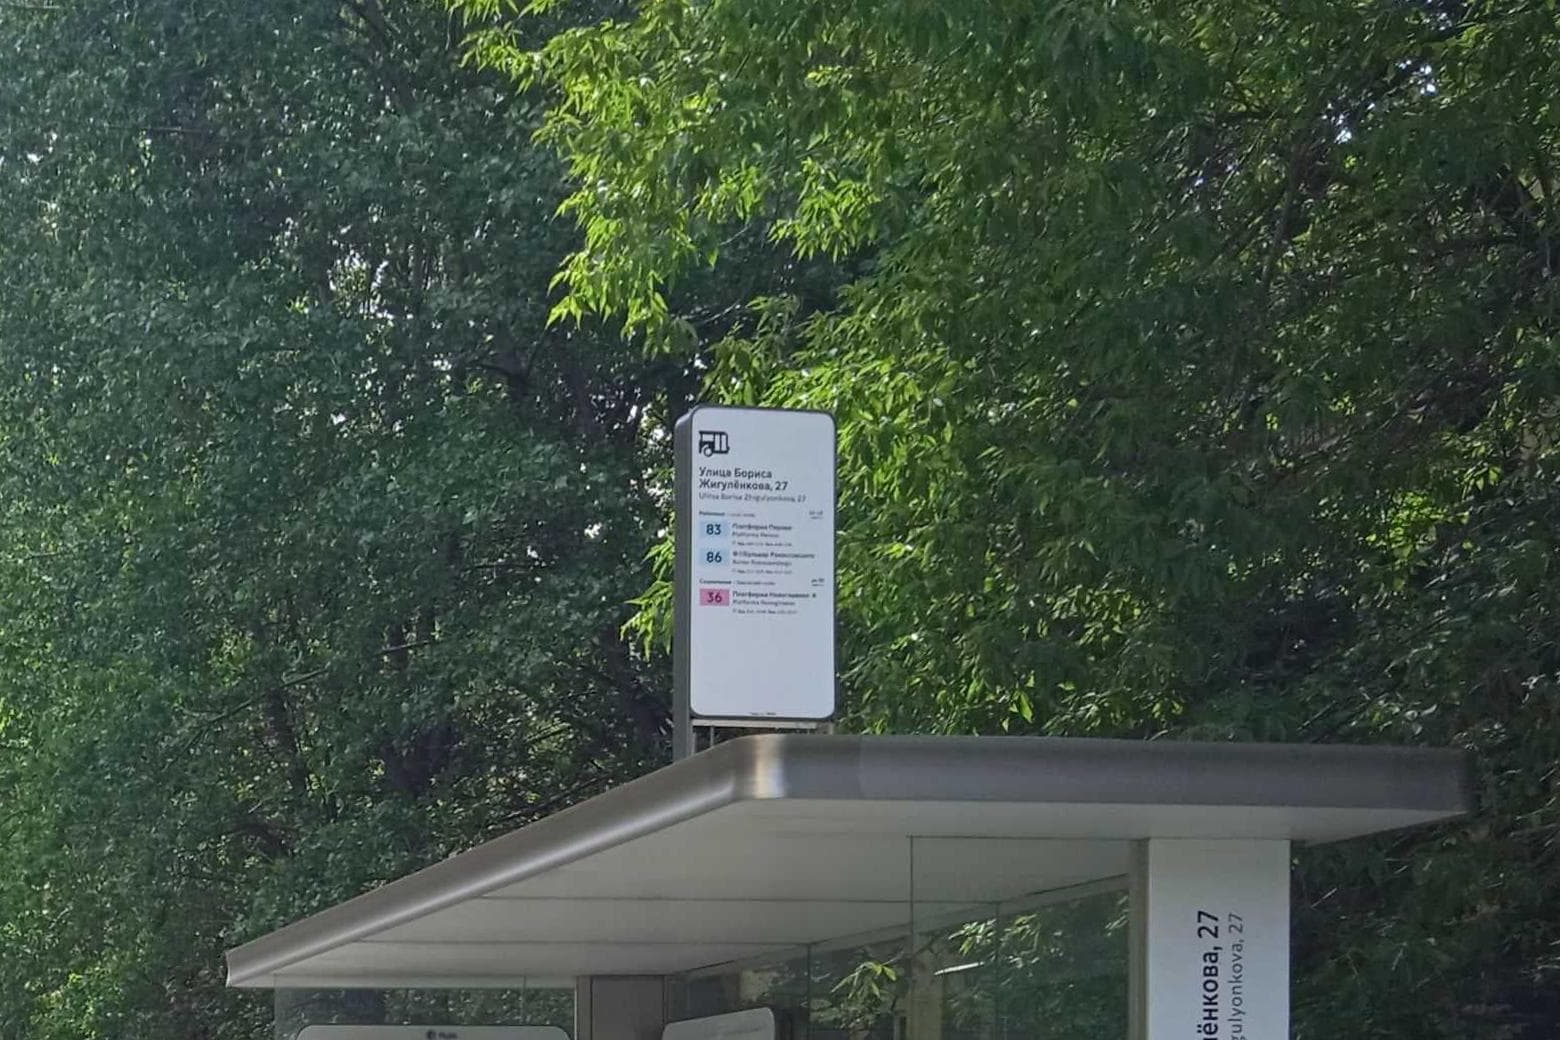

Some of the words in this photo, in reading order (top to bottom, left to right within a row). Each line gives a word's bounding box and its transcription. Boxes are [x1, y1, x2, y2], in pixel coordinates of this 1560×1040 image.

[699, 467, 731, 478] Улица
[734, 468, 772, 479] Бориса
[699, 479, 773, 491] Жигулёнкова,
[775, 481, 788, 490] 27
[706, 523, 722, 535] 83
[706, 551, 722, 563] 86
[707, 592, 722, 603] 36
[1197, 910, 1219, 939] 27
[1227, 912, 1243, 934] 27
